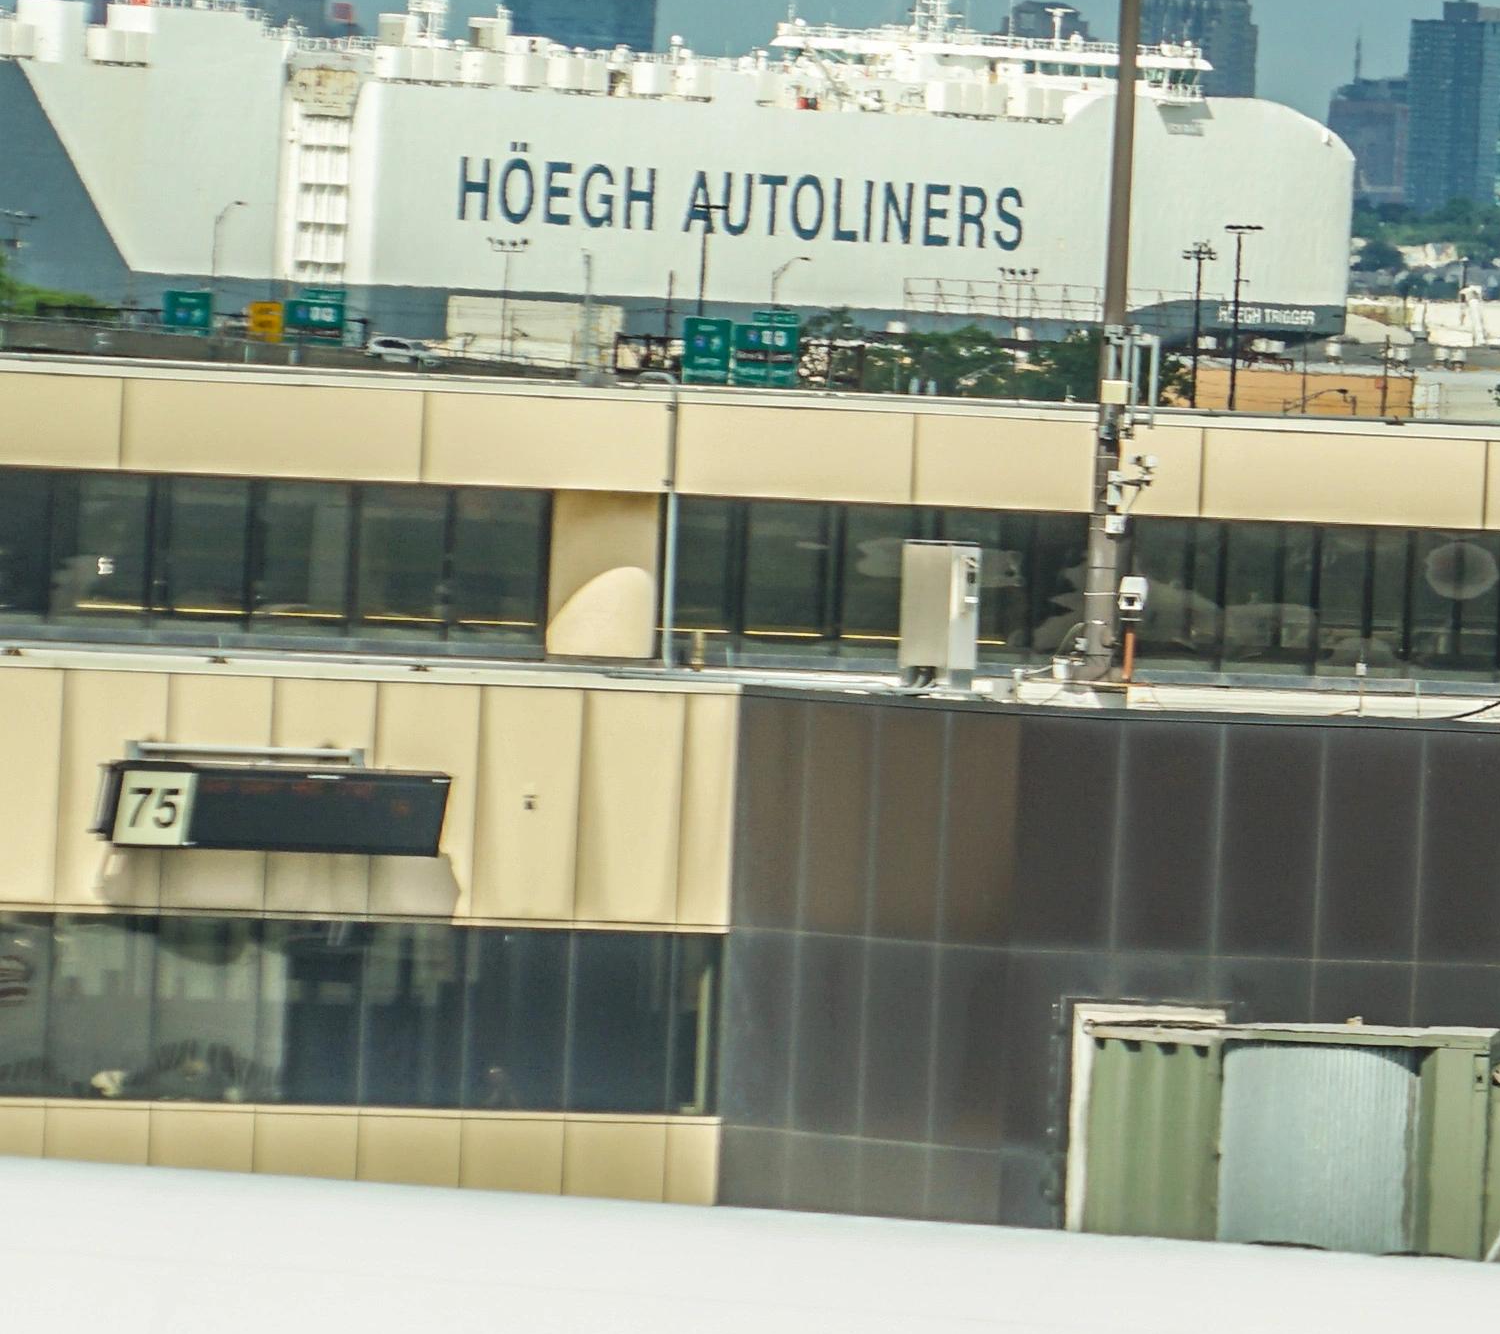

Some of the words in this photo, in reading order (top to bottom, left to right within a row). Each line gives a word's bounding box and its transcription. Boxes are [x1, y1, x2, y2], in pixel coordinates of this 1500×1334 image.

[457, 141, 656, 230] HÖEGH
[682, 170, 1024, 251] AUTOLINERS
[1264, 308, 1316, 326] TRIGGER
[127, 786, 180, 829] 75
